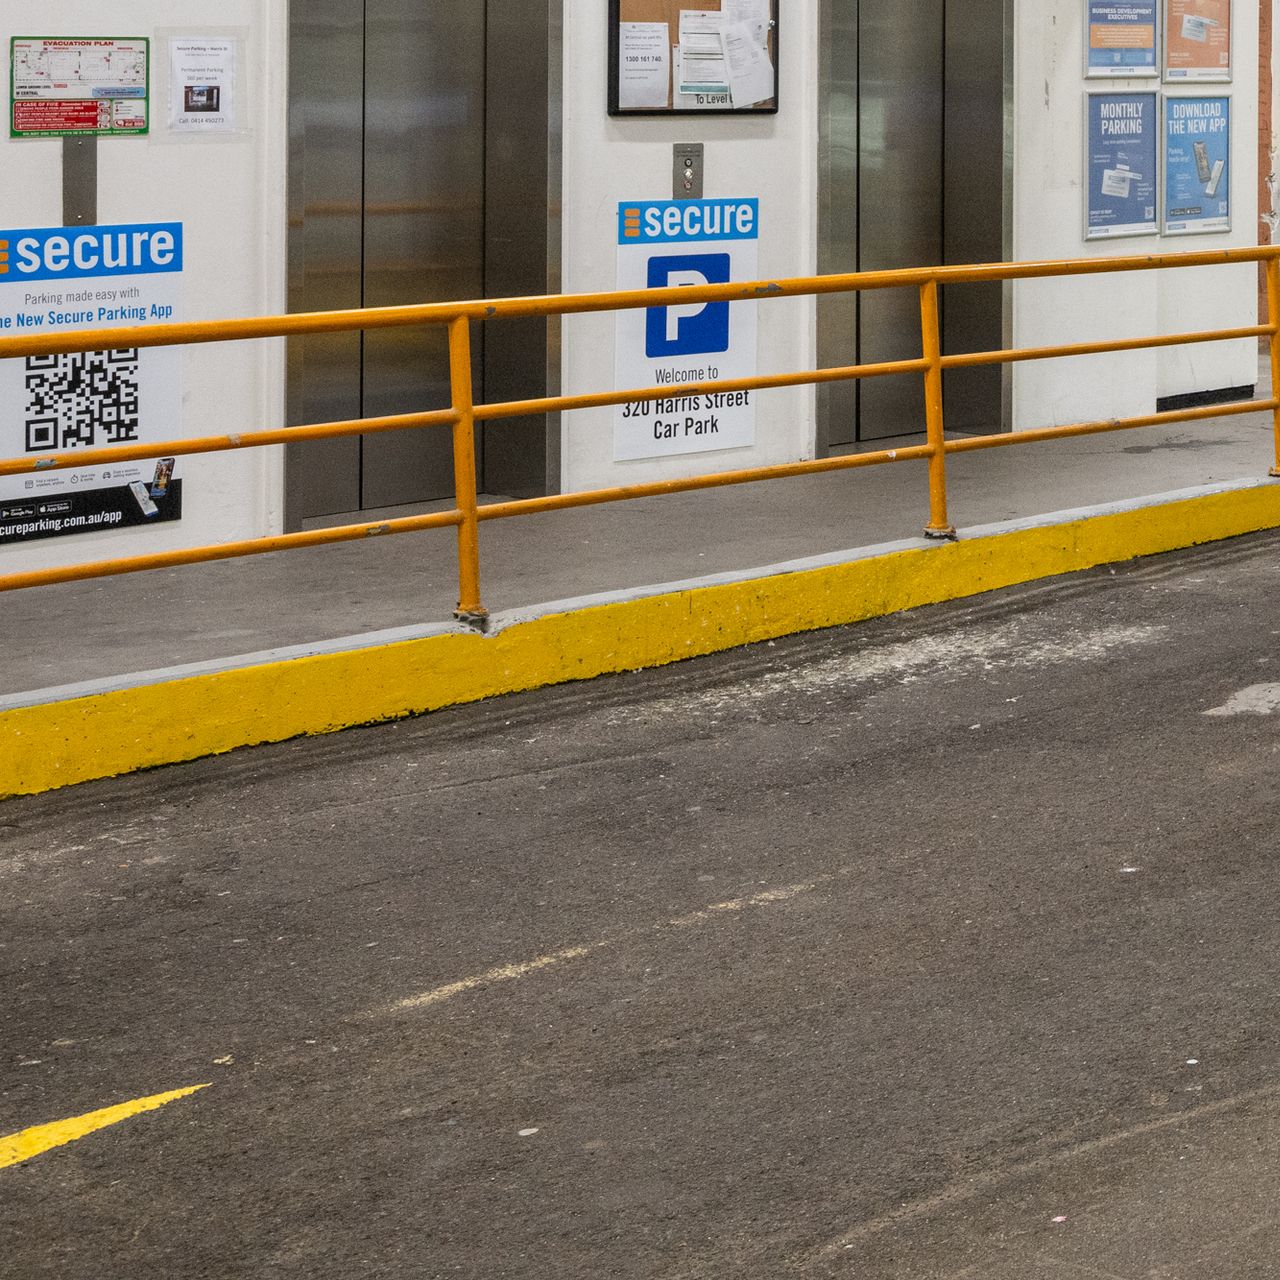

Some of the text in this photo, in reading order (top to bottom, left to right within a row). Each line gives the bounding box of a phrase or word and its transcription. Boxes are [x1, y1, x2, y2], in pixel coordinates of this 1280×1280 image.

[696, 94, 727, 104] To Level
[1101, 103, 1143, 118] MONTHLY
[1173, 103, 1221, 118] DOWNLOAD
[1101, 119, 1142, 135] PARKING
[1168, 118, 1226, 135] THE NEW APP
[644, 202, 754, 236] secure
[15, 230, 175, 273] secure
[25, 287, 140, 305] Parking made easy with
[666, 270, 709, 341] P
[17, 313, 44, 327] New
[48, 310, 94, 325] Secure
[98, 305, 147, 321] Parking
[151, 303, 173, 318] App
[655, 365, 719, 384] Welcome to
[623, 390, 749, 418] 320 Harris Street
[654, 415, 719, 439] Car Park
